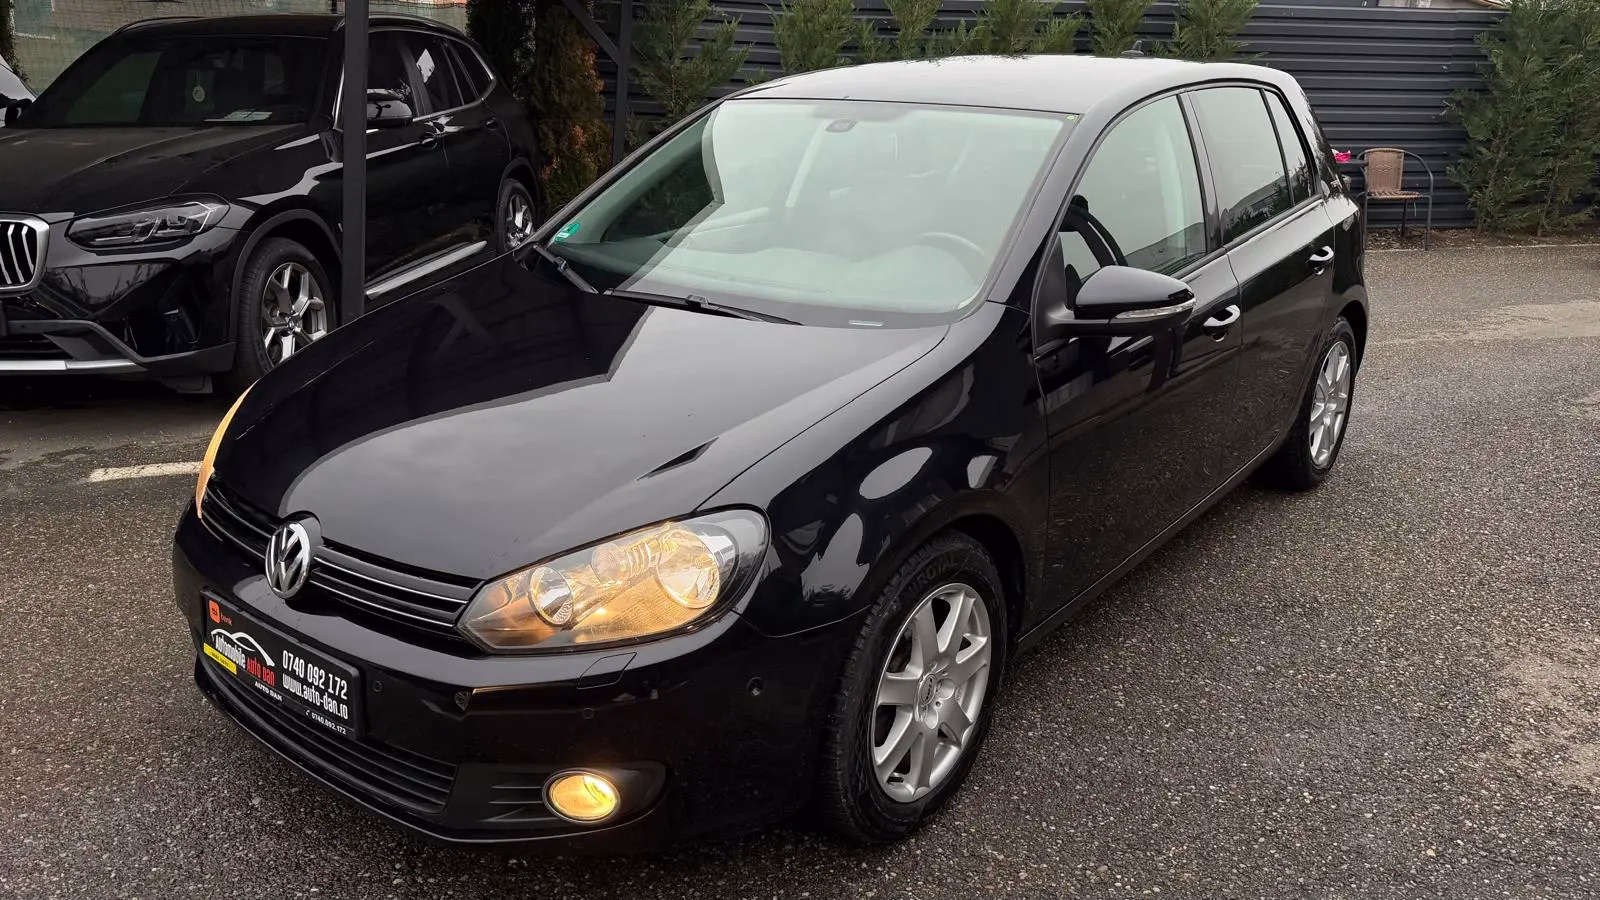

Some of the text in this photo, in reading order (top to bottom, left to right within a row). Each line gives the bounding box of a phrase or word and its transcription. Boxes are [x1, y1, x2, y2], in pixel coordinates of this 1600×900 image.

[254, 681, 283, 702] AUTO DAN
[282, 650, 348, 700] 0740 092 172
[282, 673, 348, 720] www.auto-dan.ro
[311, 712, 346, 735] 0740.092.172
